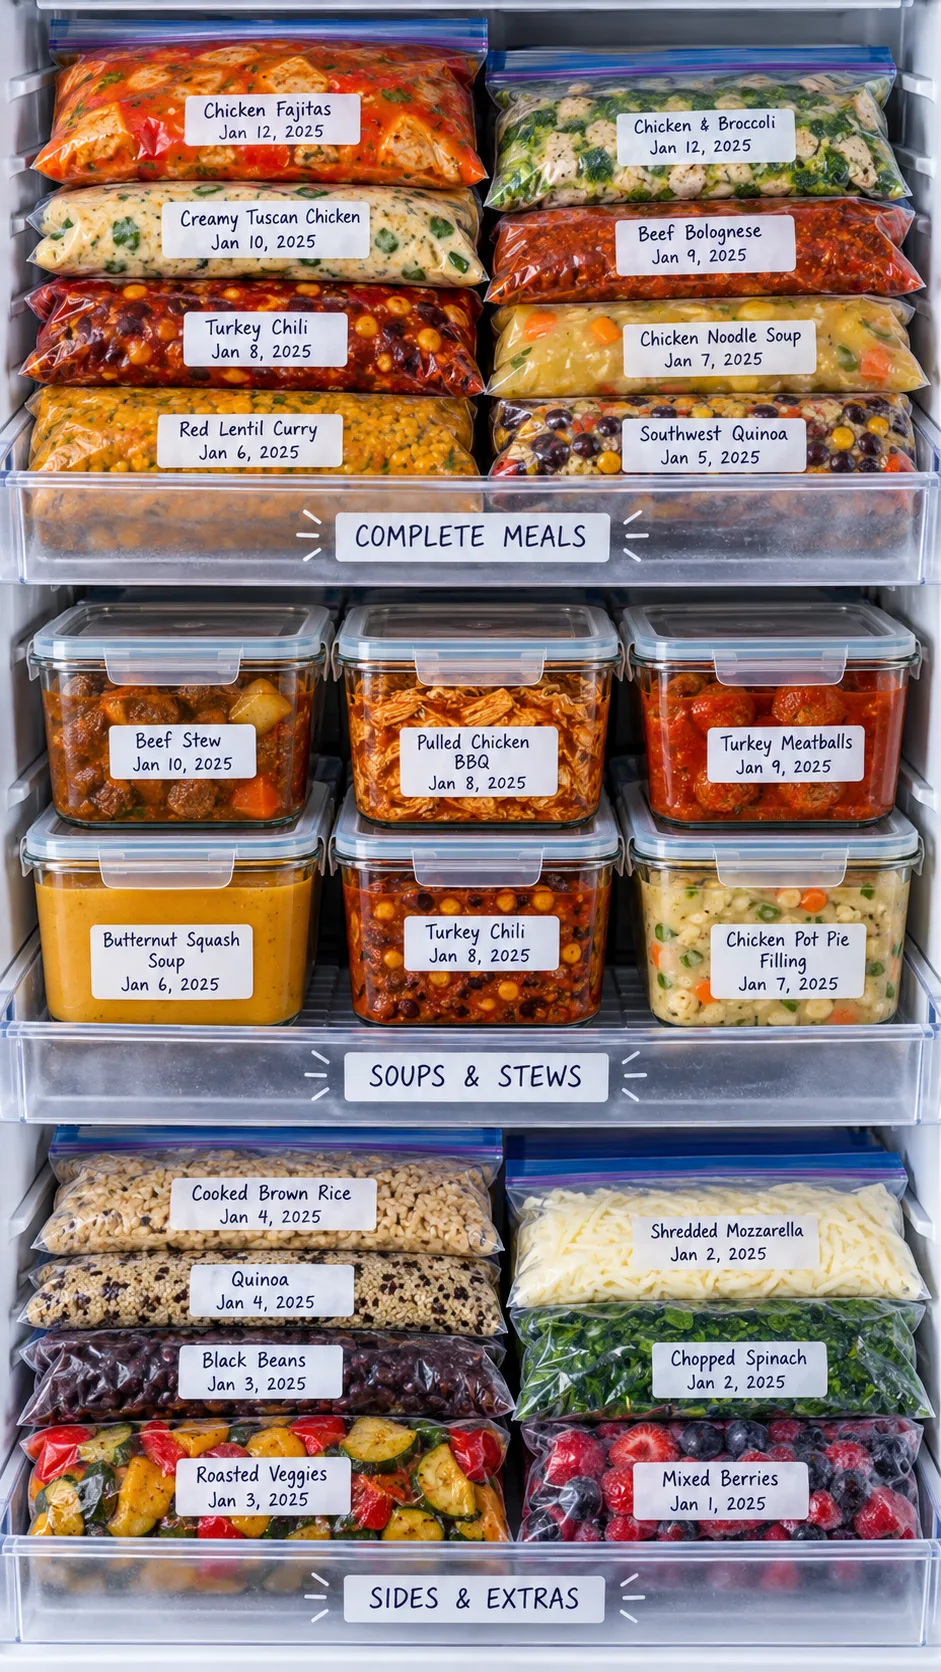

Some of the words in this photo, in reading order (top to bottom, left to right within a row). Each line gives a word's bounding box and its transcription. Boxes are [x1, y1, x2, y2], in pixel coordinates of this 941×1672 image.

[204, 101, 265, 119] Chicken
[276, 100, 331, 123] Fajitas
[219, 124, 247, 140] Jan
[257, 125, 276, 141] 12,
[285, 124, 324, 138] 2025
[634, 118, 692, 134] Chicken
[700, 117, 710, 132] &
[718, 114, 775, 131] Broccoli
[650, 140, 677, 155] Jan
[686, 140, 705, 156] 12,
[714, 138, 752, 153] 2025
[180, 210, 239, 233] Creamy
[246, 208, 298, 225] Tuscan
[306, 208, 360, 224] Chicken
[211, 234, 239, 251] Jan
[250, 235, 268, 252] 10,
[277, 234, 316, 249] 2025
[638, 224, 675, 242] Beef
[685, 223, 762, 246] Bolognese
[652, 249, 679, 265] Jan
[687, 249, 701, 266] 9,
[709, 248, 747, 263] 2025
[205, 318, 261, 342] Turkey
[272, 318, 308, 335] Chili
[640, 329, 699, 347] Chicken
[708, 327, 757, 344] Noodle
[766, 327, 801, 348] Soup
[211, 343, 240, 359] Jan
[250, 344, 263, 361] 8,
[272, 344, 312, 358] 2025
[664, 352, 692, 368] Jan
[701, 353, 715, 370] 7,
[724, 352, 763, 366] 2025
[180, 420, 209, 438] Red
[219, 420, 263, 437] Lentil
[273, 420, 318, 443] Curry
[640, 425, 722, 442] Southwest
[732, 425, 788, 442] Quinoa
[199, 444, 227, 460] Jan
[237, 445, 251, 462] 6,
[260, 445, 299, 459] 2025
[660, 449, 688, 465] Jan
[698, 450, 712, 467] 5,
[720, 450, 760, 464] 2025
[355, 524, 485, 547] COMPLETE
[503, 524, 586, 548] MEALS
[136, 730, 172, 749] Beef
[182, 732, 221, 748] Stew
[417, 733, 461, 751] Pulled
[471, 733, 529, 750] Chicken
[720, 734, 772, 757] Turkey
[781, 733, 853, 751] Meatballs
[132, 756, 160, 772] Jan
[169, 758, 186, 774] 10,
[195, 757, 233, 771] 2025
[454, 754, 490, 770] BBQ
[736, 759, 763, 775] Jan
[772, 759, 785, 777] 9,
[794, 759, 832, 773] 2025
[428, 775, 456, 791] Jan
[466, 776, 479, 793] 8,
[488, 776, 526, 790] 2025
[103, 931, 178, 948] Butternut
[186, 931, 240, 953] Squash
[425, 923, 480, 946] Turkey
[490, 922, 525, 940] Chili
[726, 931, 785, 948] Chicken
[795, 930, 819, 947] Pot
[827, 930, 850, 947] Pie
[148, 952, 185, 974] Soup
[429, 947, 457, 963] Jan
[468, 948, 481, 965] 8,
[490, 948, 530, 963] 2025
[760, 952, 806, 975] Filling
[121, 976, 149, 992] Jan
[158, 977, 172, 994] 6,
[181, 977, 220, 991] 2025
[738, 976, 766, 991] Jan
[776, 977, 790, 994] 7,
[799, 977, 839, 991] 2025
[369, 1064, 445, 1087] SOUPS
[464, 1065, 479, 1087] &
[498, 1064, 581, 1088] STEWS
[192, 1183, 248, 1201] Cooked
[259, 1184, 308, 1201] Brown
[318, 1184, 352, 1201] Rice
[220, 1208, 248, 1225] Jan
[258, 1210, 273, 1227] 4,
[282, 1210, 322, 1224] 2025
[651, 1222, 718, 1239] Shredded
[726, 1221, 804, 1238] Mozzarella
[670, 1246, 697, 1262] Jan
[706, 1247, 720, 1263] 2,
[729, 1247, 767, 1261] 2025
[232, 1270, 289, 1288] Quinoa
[216, 1294, 244, 1310] Jan
[253, 1295, 267, 1312] 4,
[276, 1295, 315, 1309] 2025
[202, 1351, 247, 1369] Black
[258, 1351, 306, 1368] Beans
[671, 1348, 735, 1372] Chopped
[746, 1348, 807, 1372] Spinach
[207, 1375, 235, 1392] Jan
[245, 1376, 258, 1394] 3,
[267, 1376, 306, 1391] 2025
[687, 1374, 715, 1390] Jan
[724, 1375, 738, 1392] 2,
[746, 1375, 786, 1389] 2025
[197, 1464, 259, 1484] Roasted
[269, 1464, 327, 1489] Veggies
[662, 1469, 710, 1487] Mixed
[721, 1469, 778, 1487] Berries
[208, 1491, 236, 1508] Jan
[246, 1492, 260, 1511] 3,
[269, 1492, 309, 1507] 2025
[670, 1495, 698, 1512] Jan
[709, 1497, 718, 1514] 1,
[727, 1496, 766, 1511] 2025
[369, 1586, 438, 1609] SIDES
[456, 1587, 471, 1609] &
[487, 1587, 579, 1610] EXTRAS
